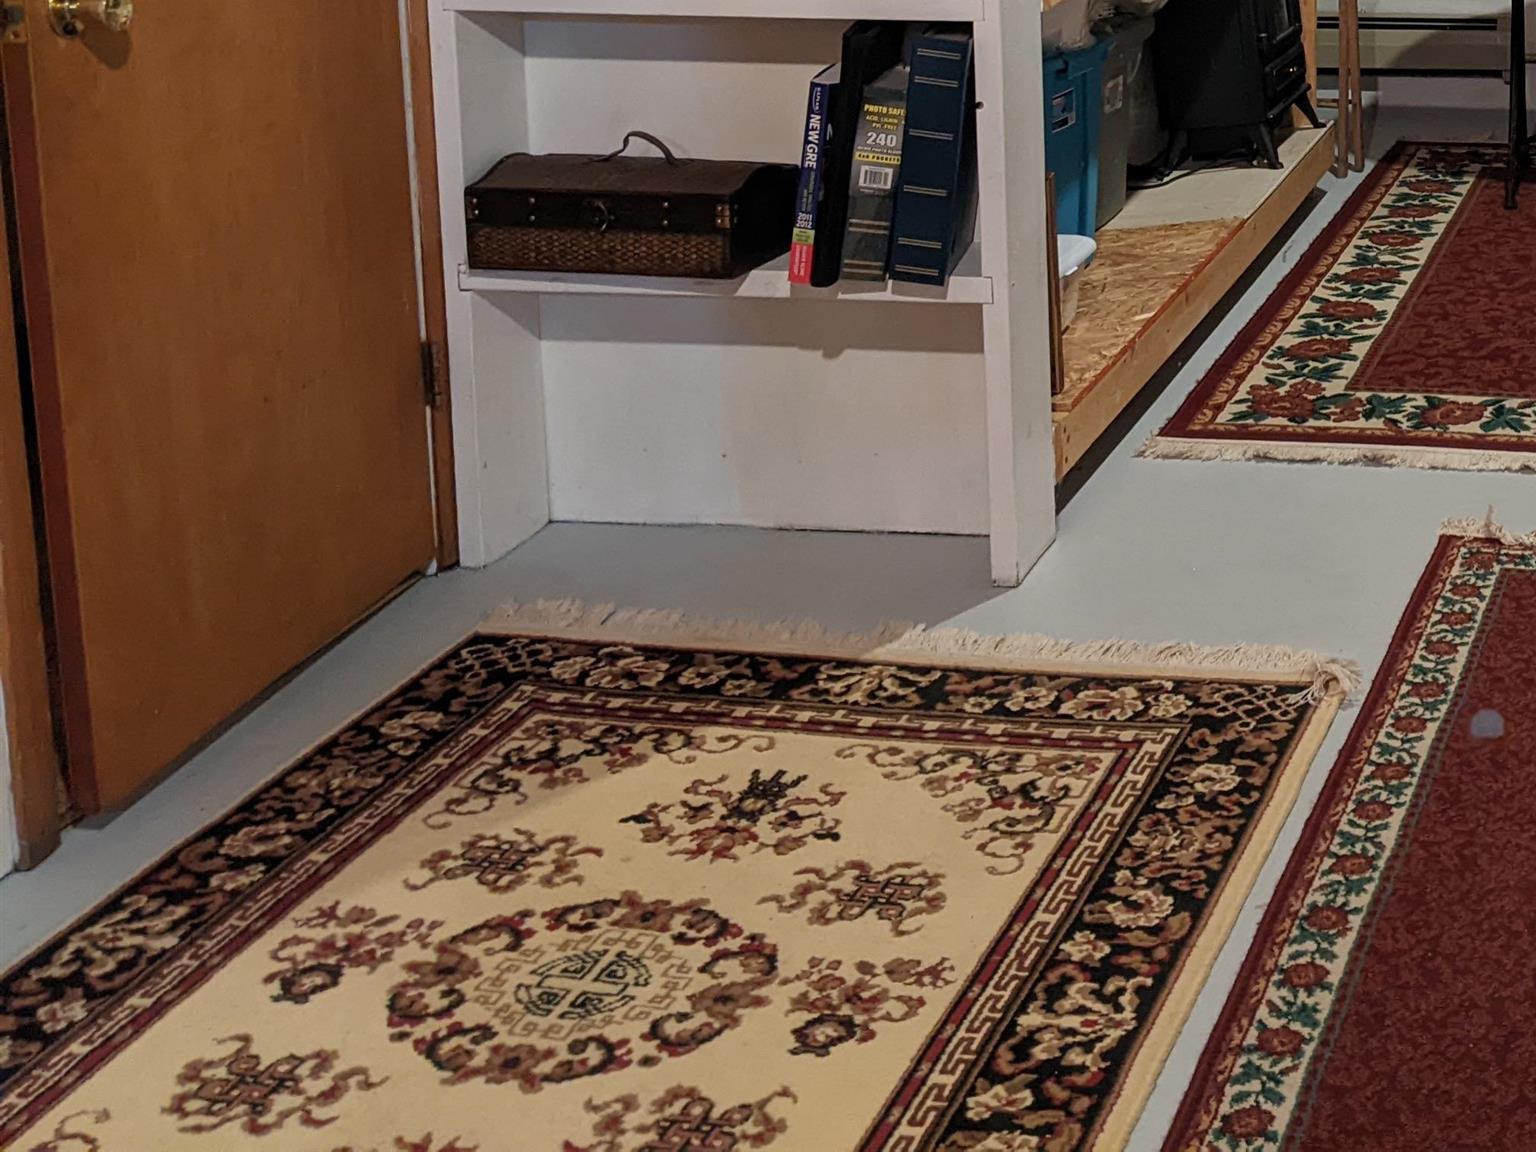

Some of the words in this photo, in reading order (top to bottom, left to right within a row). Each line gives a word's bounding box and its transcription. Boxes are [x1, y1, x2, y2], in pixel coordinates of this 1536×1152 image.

[863, 104, 888, 114] PHOTO
[807, 113, 822, 144] NEW
[865, 131, 898, 148] 240
[804, 143, 819, 170] GRE
[798, 212, 813, 221] 2011
[796, 219, 813, 229] 2012
